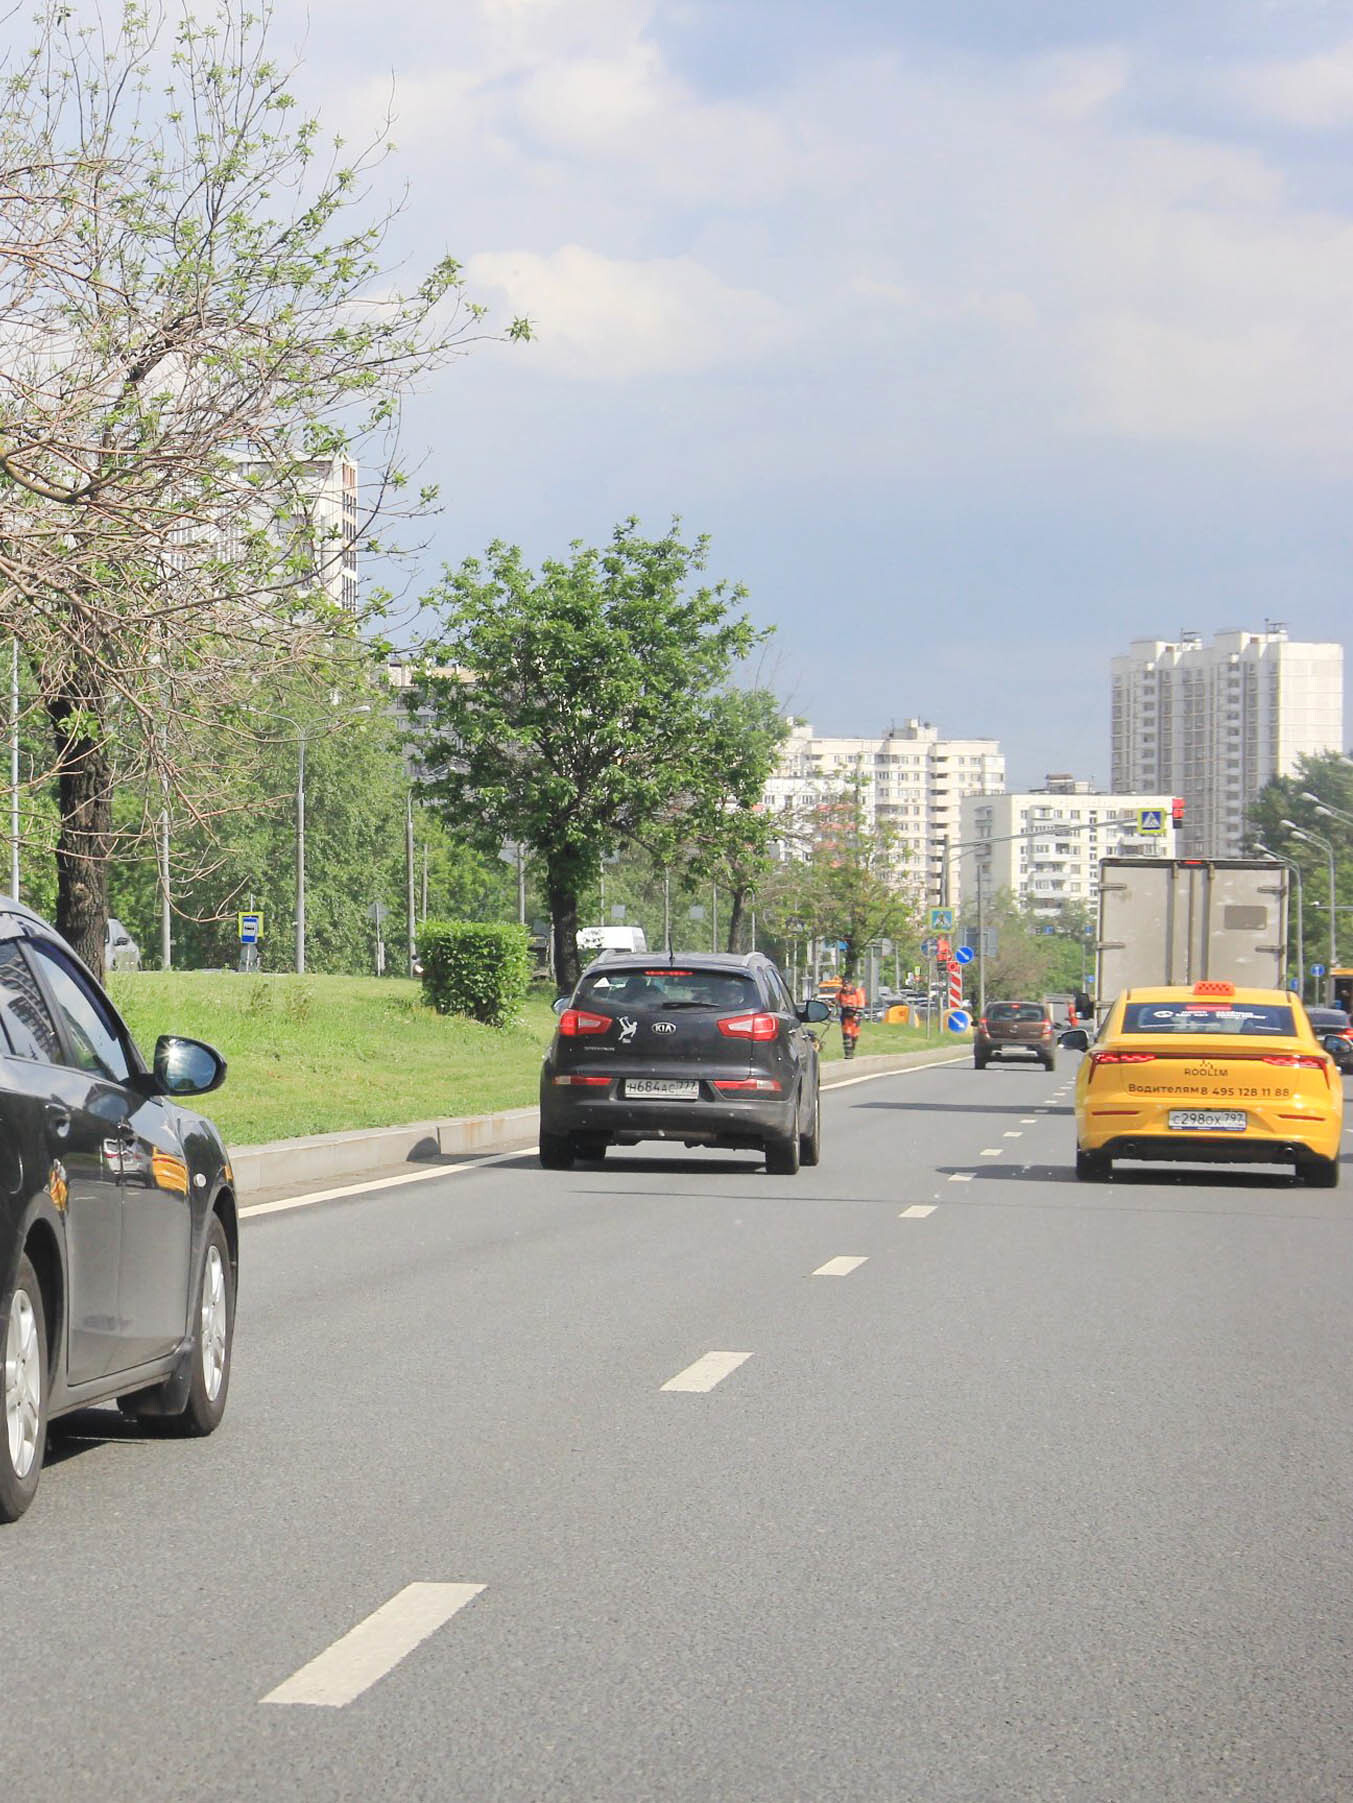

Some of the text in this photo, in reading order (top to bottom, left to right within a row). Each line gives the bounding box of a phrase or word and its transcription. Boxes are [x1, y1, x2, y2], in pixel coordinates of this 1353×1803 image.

[1128, 1084, 1290, 1097] Водителям 8 495 128 11 88
